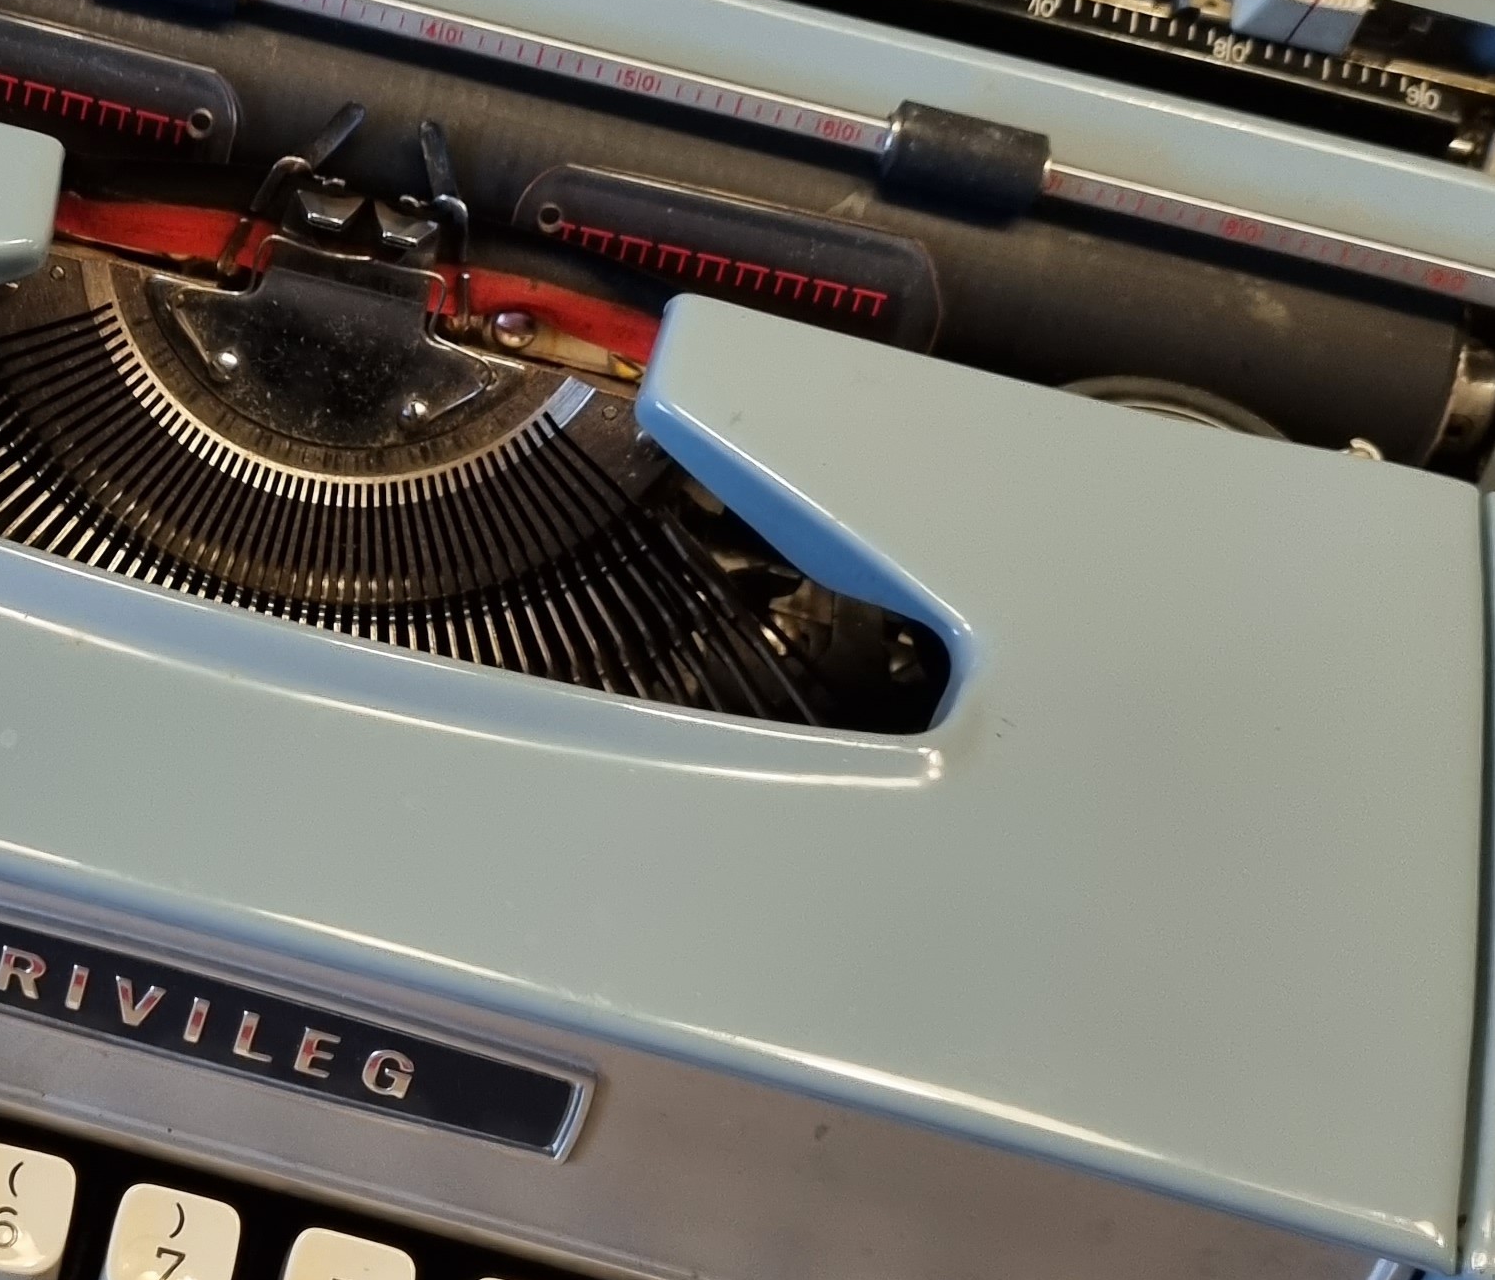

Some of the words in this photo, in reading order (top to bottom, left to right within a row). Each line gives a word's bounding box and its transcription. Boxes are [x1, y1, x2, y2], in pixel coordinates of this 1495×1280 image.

[623, 69, 654, 91] 50
[1213, 40, 1247, 63] 80
[1408, 84, 1440, 111] 90
[9, 1162, 23, 1197] (
[170, 1203, 184, 1238] )
